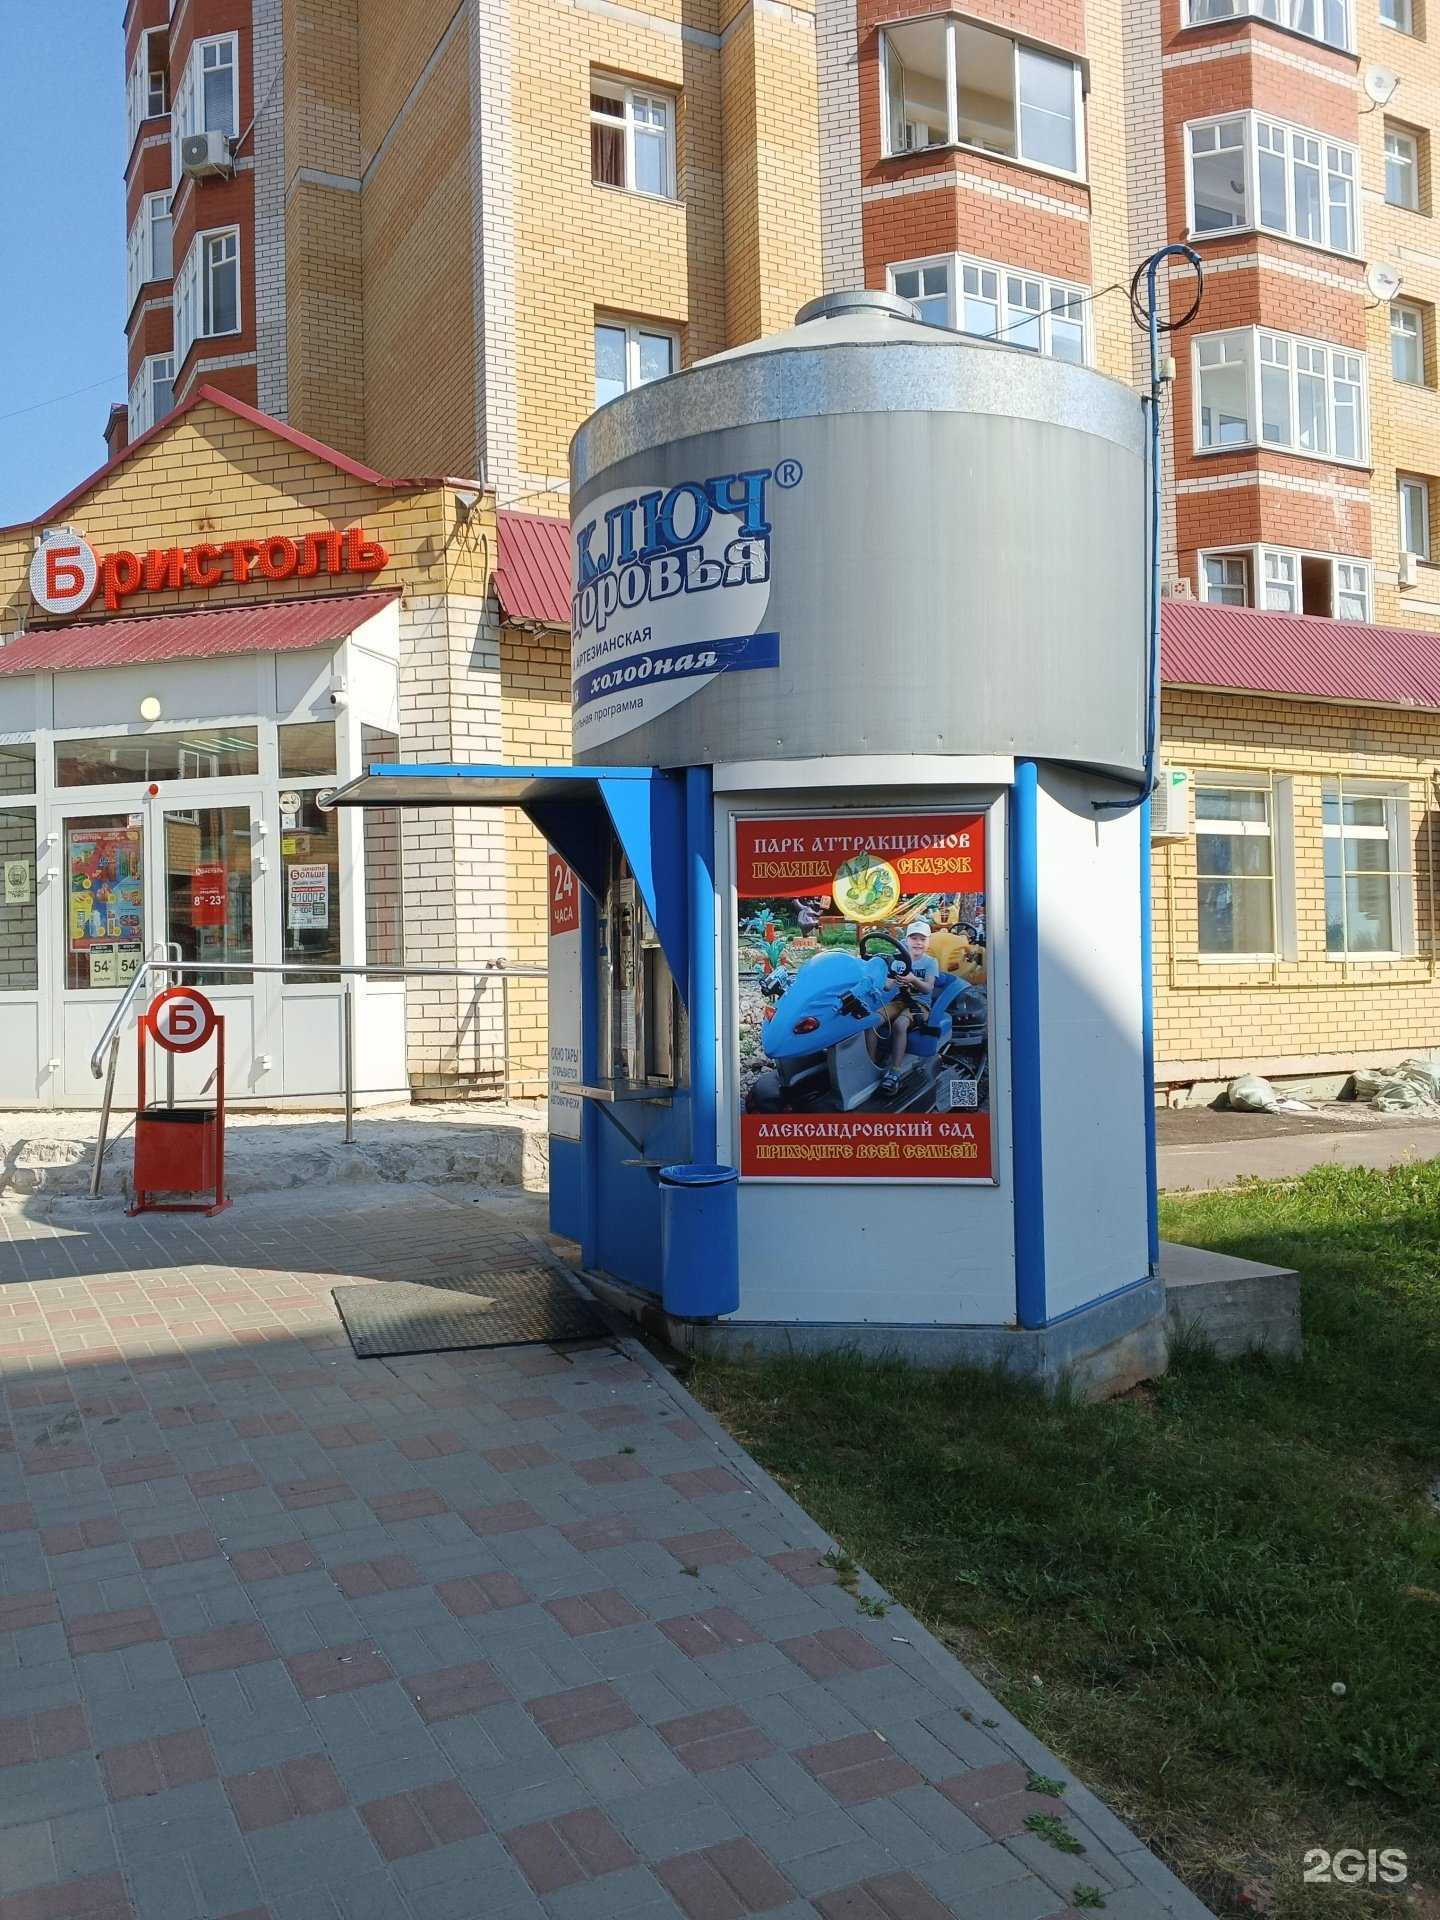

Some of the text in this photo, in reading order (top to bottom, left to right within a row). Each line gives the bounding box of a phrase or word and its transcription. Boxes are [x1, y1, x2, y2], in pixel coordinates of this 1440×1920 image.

[577, 468, 772, 588] КЛЮЧ
[43, 527, 391, 611] Бристоль
[571, 534, 770, 646] доровья
[590, 650, 718, 694] холодная
[594, 697, 643, 722] программа
[754, 833, 970, 854] ПАРК АТТРАКЦИОНОВ
[752, 856, 973, 878] ПОЛЯНА СКАЗОК
[554, 865, 572, 901] 24
[554, 905, 574, 923] ЧАСА
[168, 1004, 198, 1036] Б
[758, 1120, 975, 1138] АЛЕКСАНДРОВСКИЙ САД
[756, 1142, 978, 1161] ПРИХОДИТЕ ВСЕЙ СЕМЬЕЙ!
